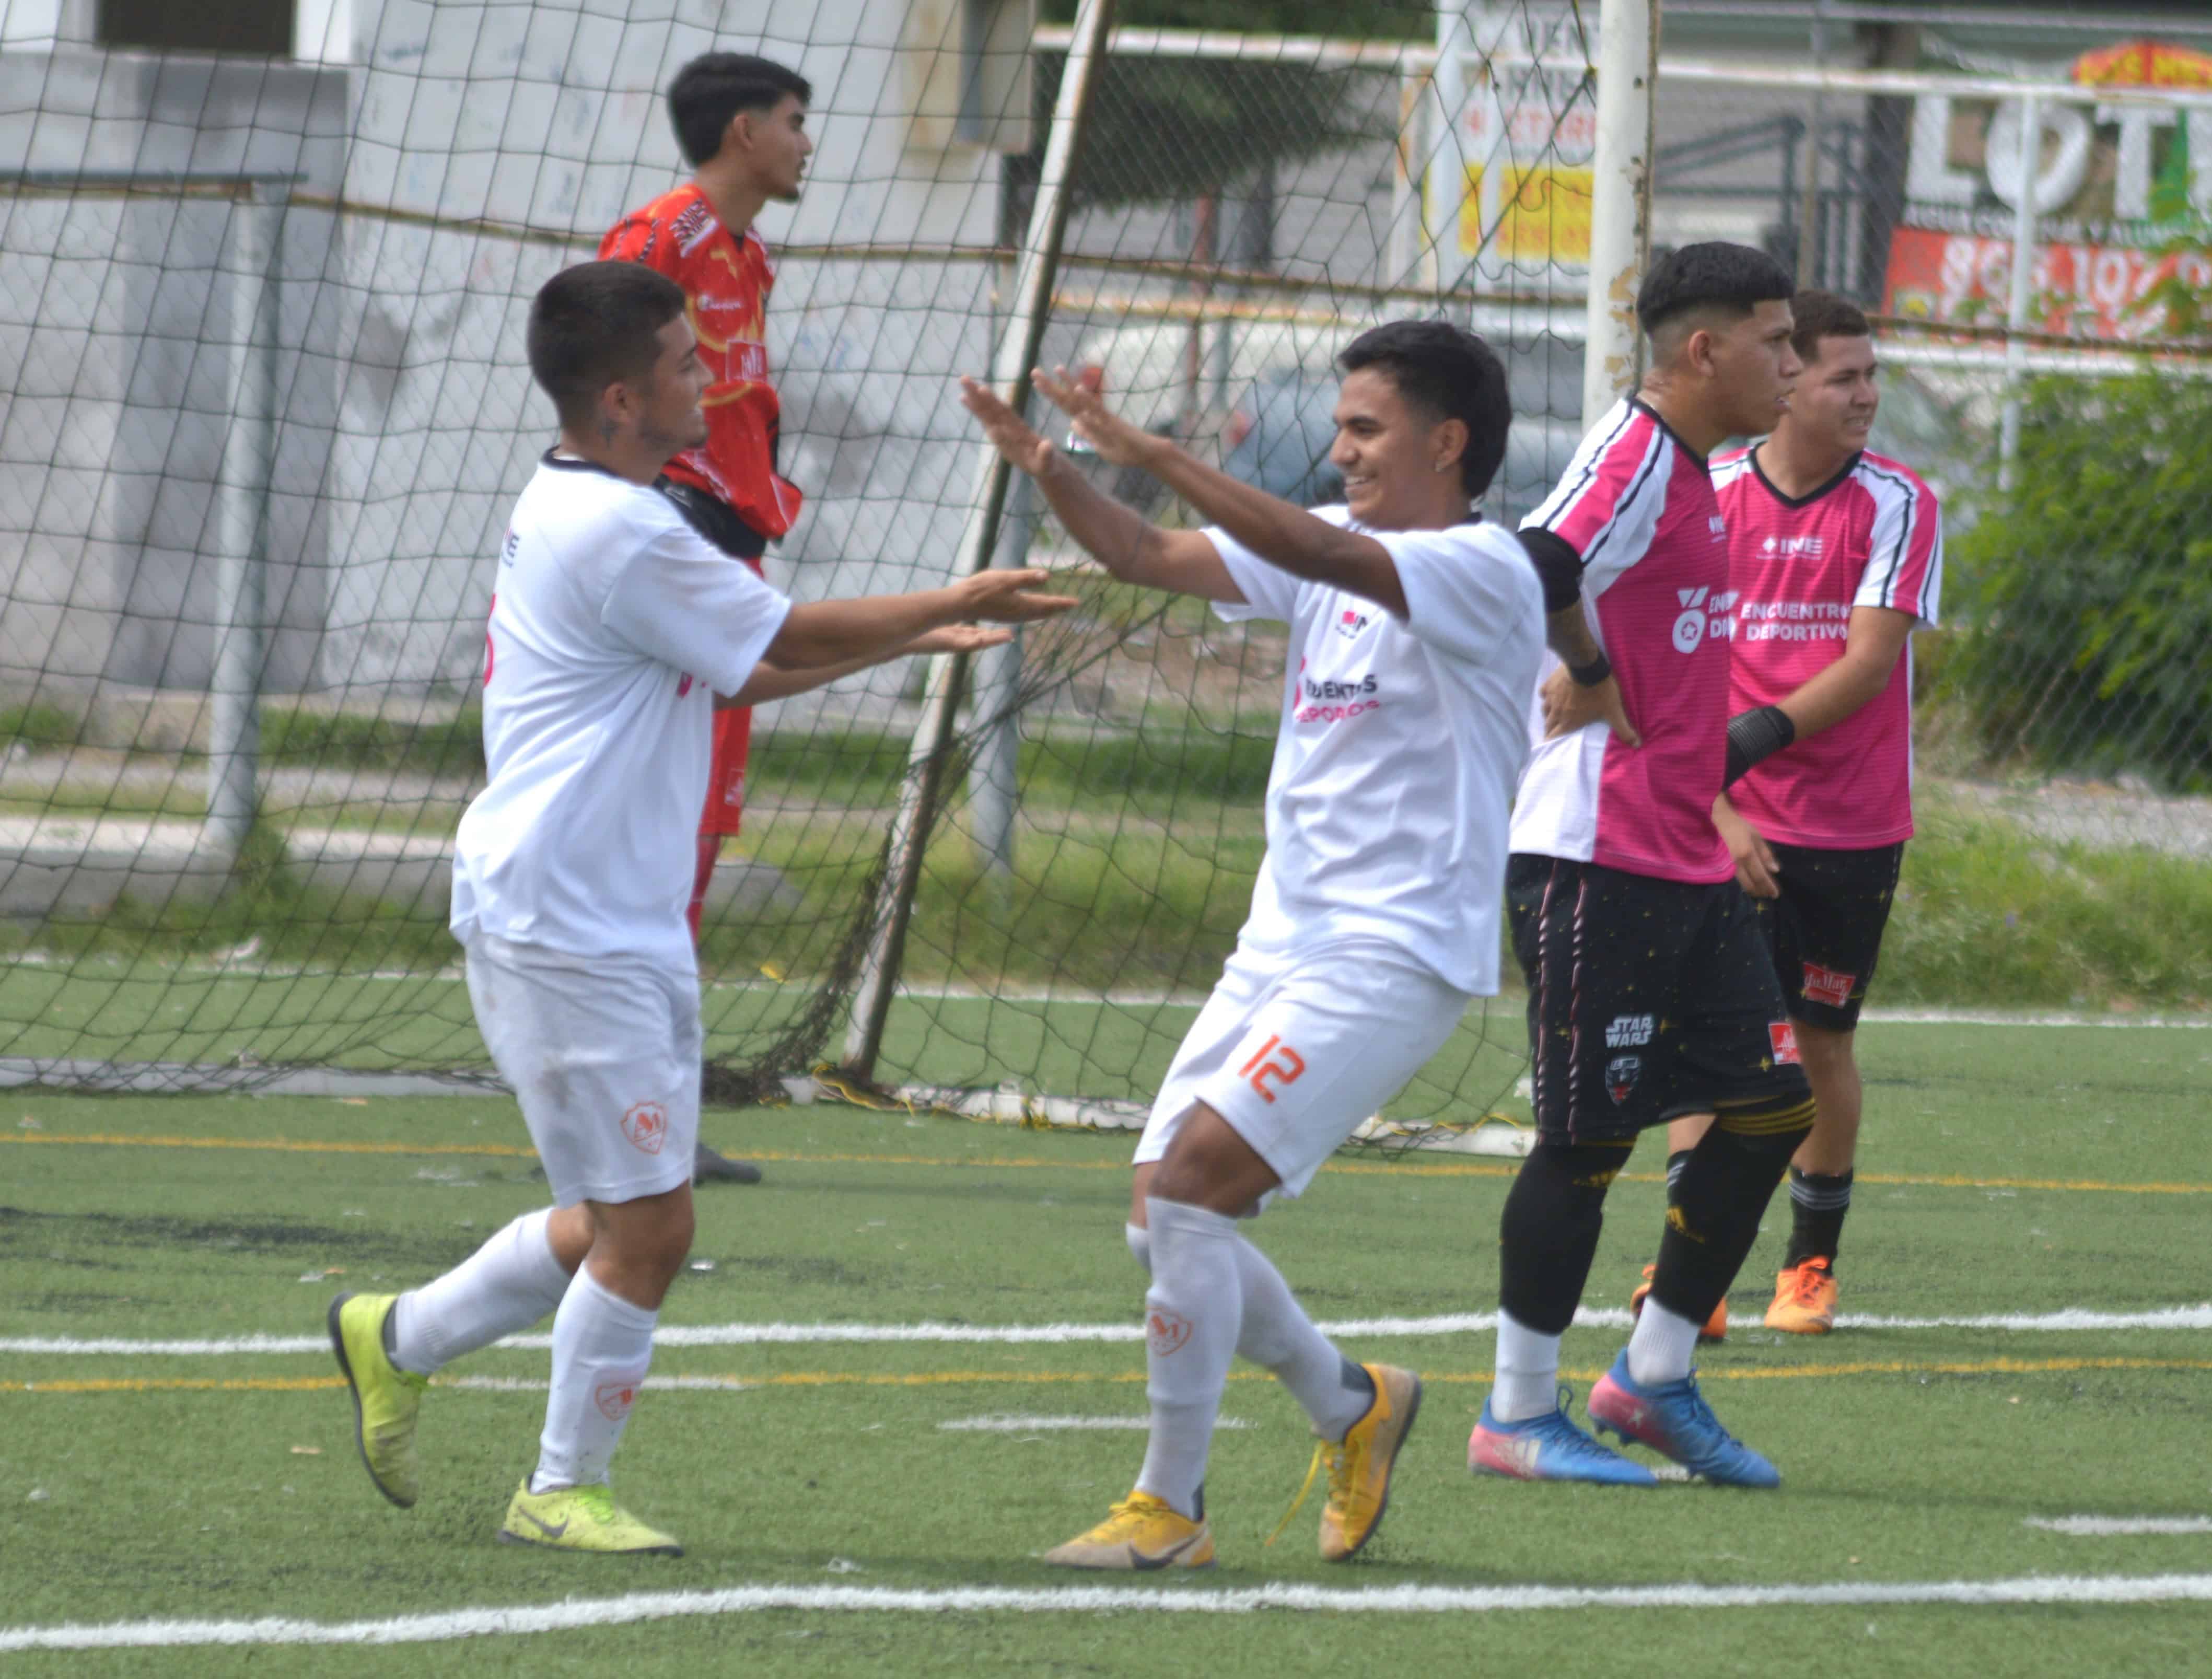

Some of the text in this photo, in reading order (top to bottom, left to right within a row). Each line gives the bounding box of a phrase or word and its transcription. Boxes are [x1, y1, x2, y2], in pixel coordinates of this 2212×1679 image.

[1780, 537, 1823, 555] INE
[1605, 1015, 1654, 1033] STAR
[1605, 1031, 1652, 1048] WARS
[1238, 1034, 1306, 1106] 12
